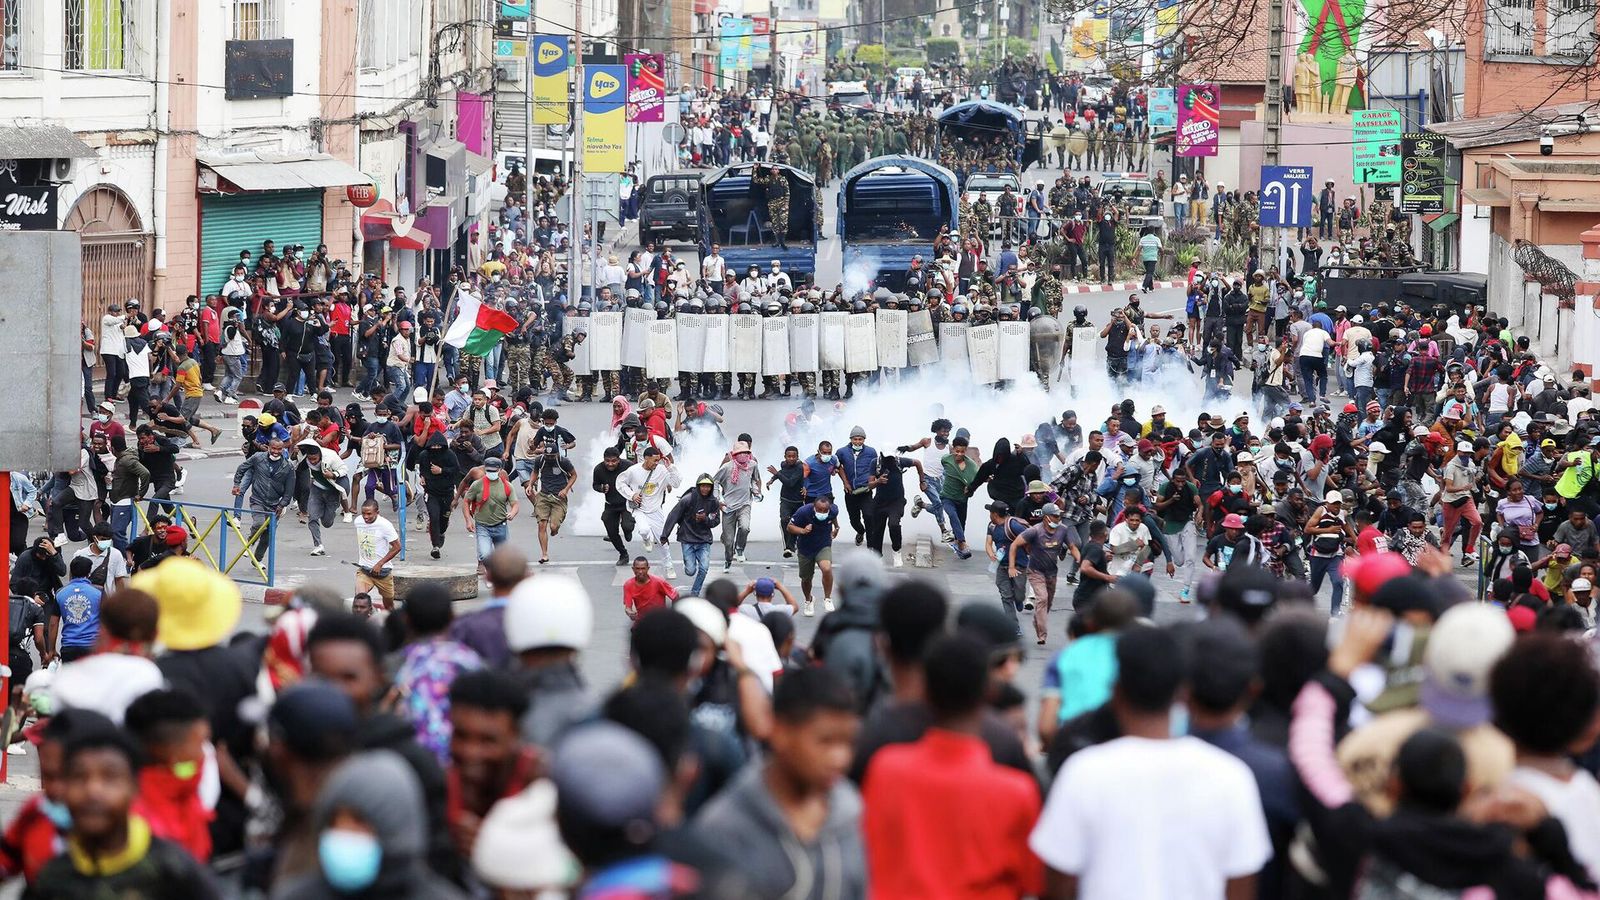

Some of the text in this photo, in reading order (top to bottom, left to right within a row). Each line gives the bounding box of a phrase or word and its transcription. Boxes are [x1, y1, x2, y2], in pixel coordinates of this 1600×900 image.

[542, 49, 559, 58] yas
[594, 80, 615, 92] yas
[1355, 119, 1398, 128] MATSELAKA
[351, 186, 369, 199] THB
